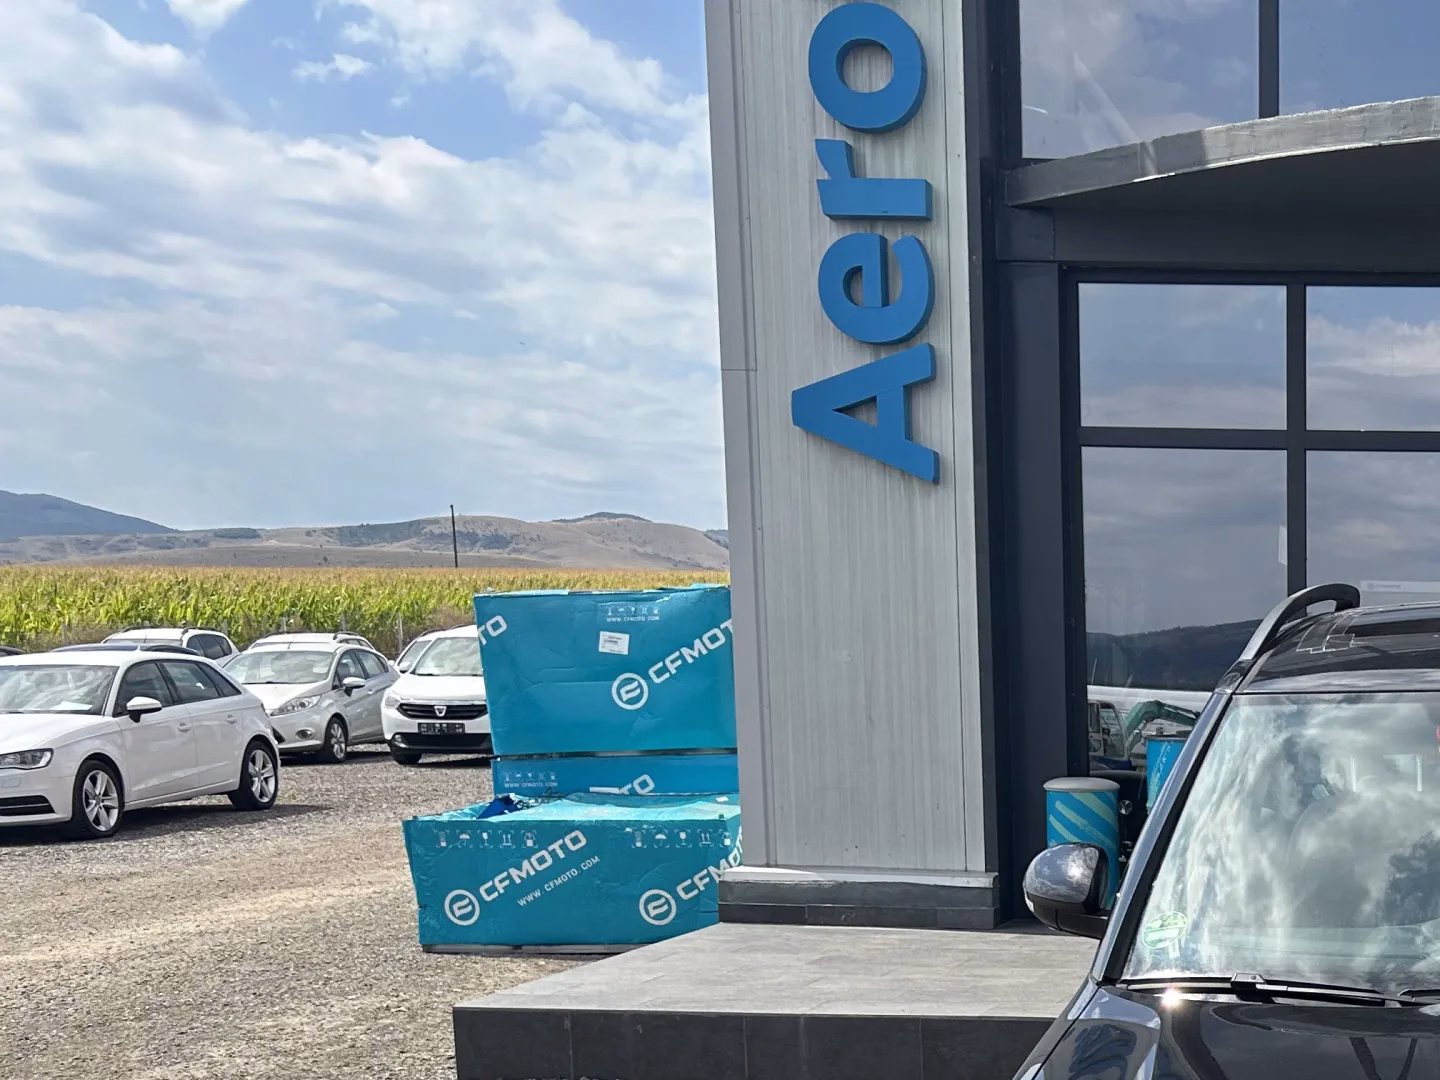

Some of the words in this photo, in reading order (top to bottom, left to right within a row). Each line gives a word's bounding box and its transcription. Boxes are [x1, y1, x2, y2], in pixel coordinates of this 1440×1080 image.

[792, 2, 940, 485] Aero
[648, 618, 733, 684] CFMOT
[479, 829, 587, 902] CFMOTO
